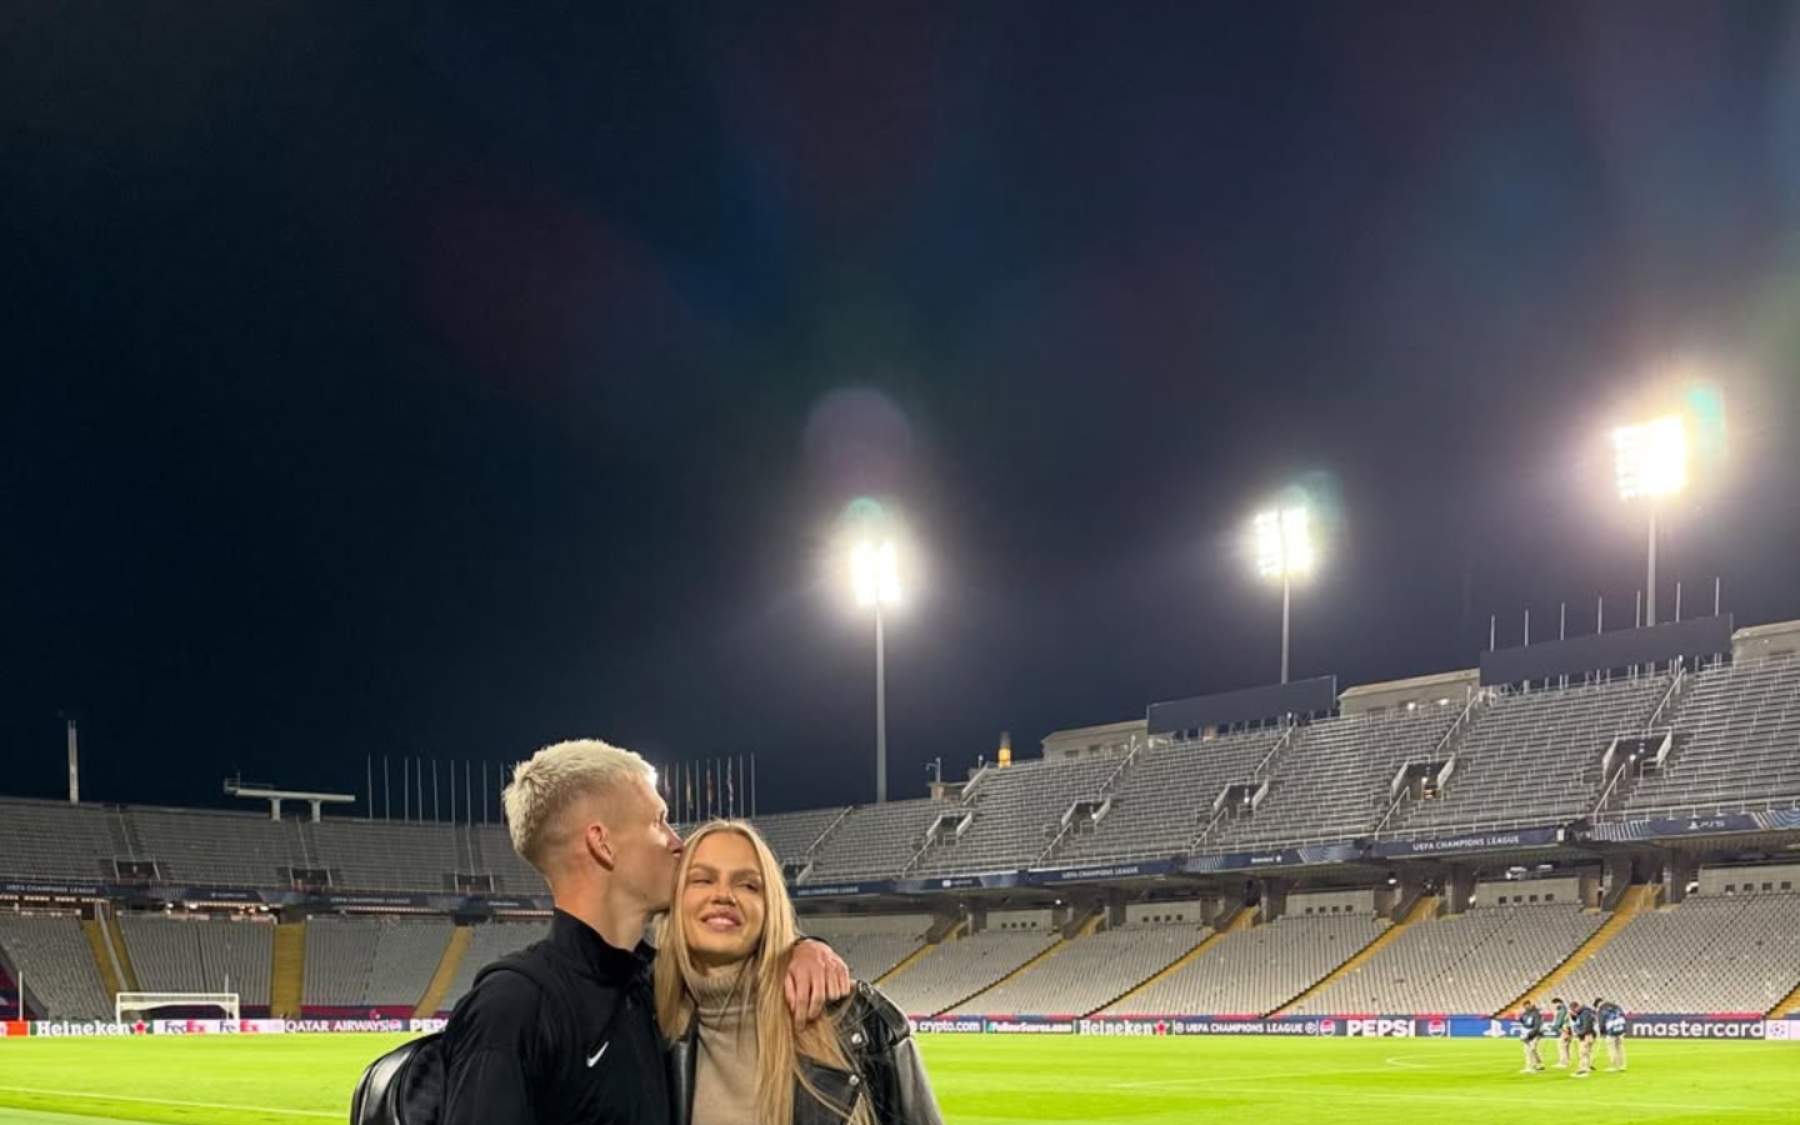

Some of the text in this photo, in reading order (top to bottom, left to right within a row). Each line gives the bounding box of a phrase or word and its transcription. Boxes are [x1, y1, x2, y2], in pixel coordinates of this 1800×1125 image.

[1412, 835, 1520, 851] UEFA CHAMPIONS LEAGUE
[36, 1019, 132, 1037] Heineken
[163, 1018, 207, 1036] FedEx
[285, 1019, 387, 1034] QATAR AIRWAYS
[409, 1018, 449, 1034] PEP
[919, 1020, 981, 1034] crypto.com
[1079, 1019, 1154, 1035] Heineken
[1185, 1022, 1304, 1033] UEFA CHAMPIONS LEAGUE
[1346, 1019, 1416, 1037] PEPSI
[1632, 1020, 1764, 1037] mastercard
